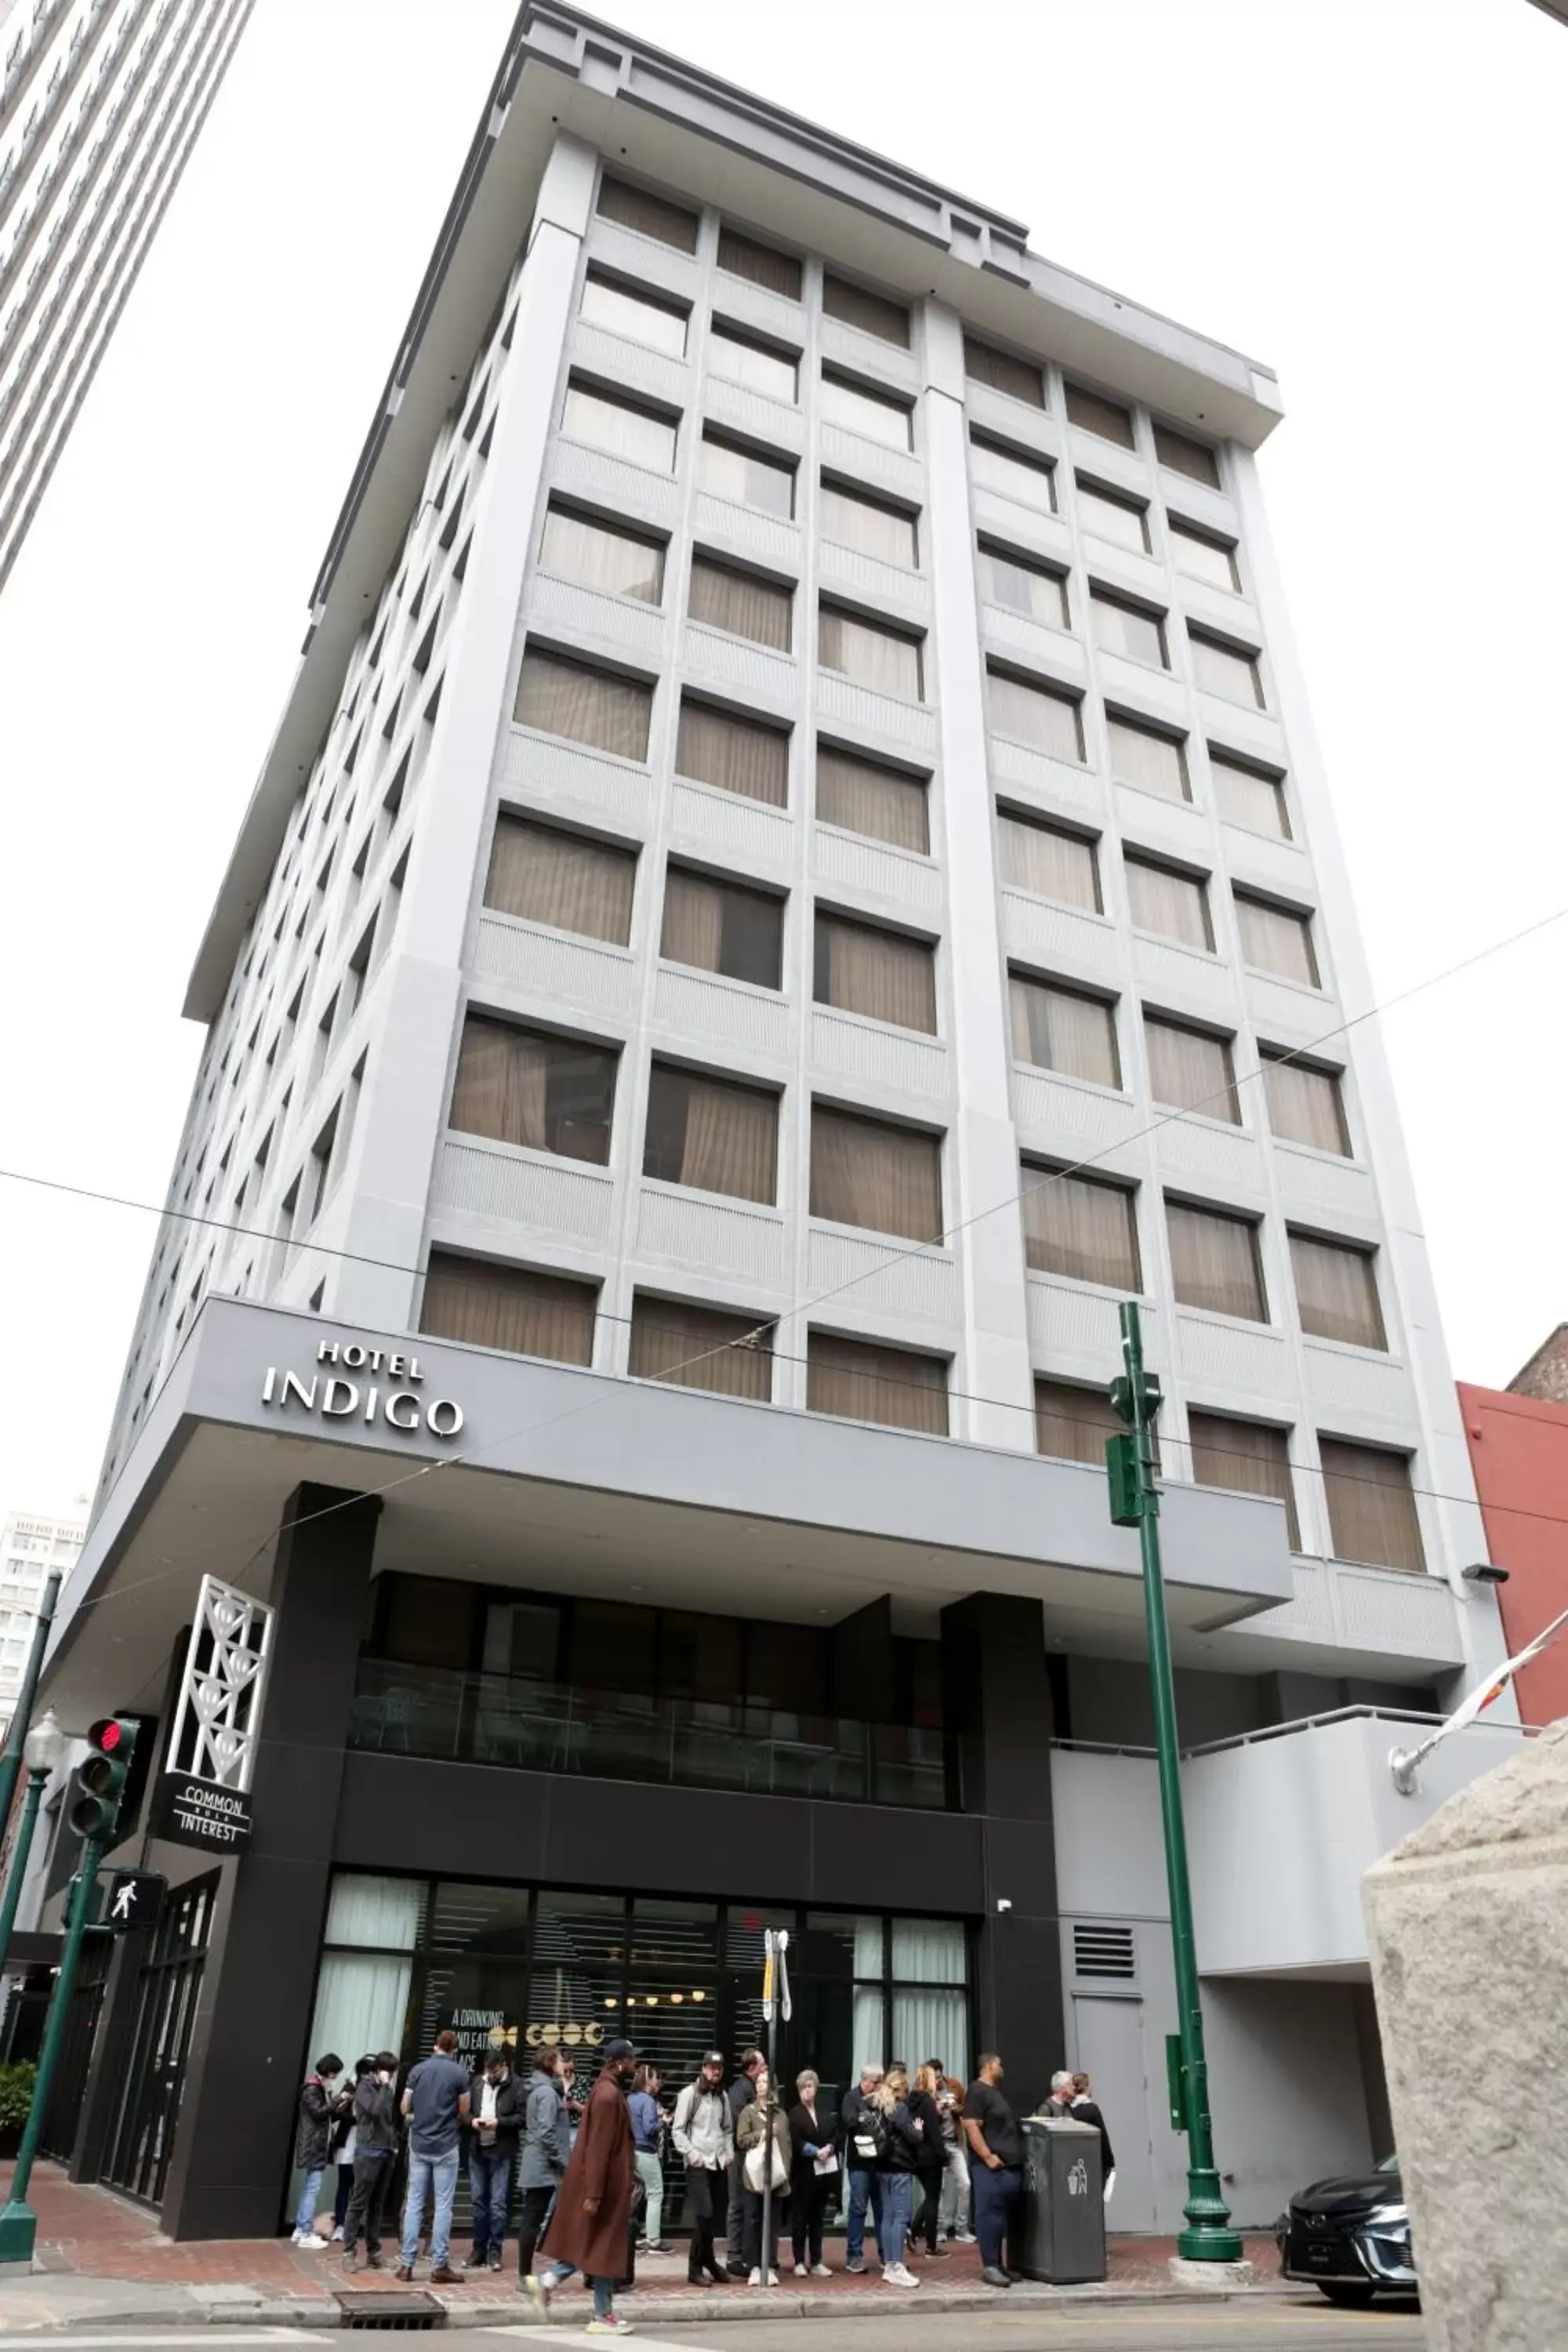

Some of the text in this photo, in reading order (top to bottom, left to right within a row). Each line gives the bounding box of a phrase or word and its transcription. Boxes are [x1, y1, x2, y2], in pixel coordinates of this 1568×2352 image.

[316, 1339, 425, 1381] HOTEL
[261, 1367, 465, 1436] INDIGO
[185, 1785, 242, 1815] COMMON
[180, 1814, 236, 1842] INTEREST
[451, 2009, 459, 2026] A
